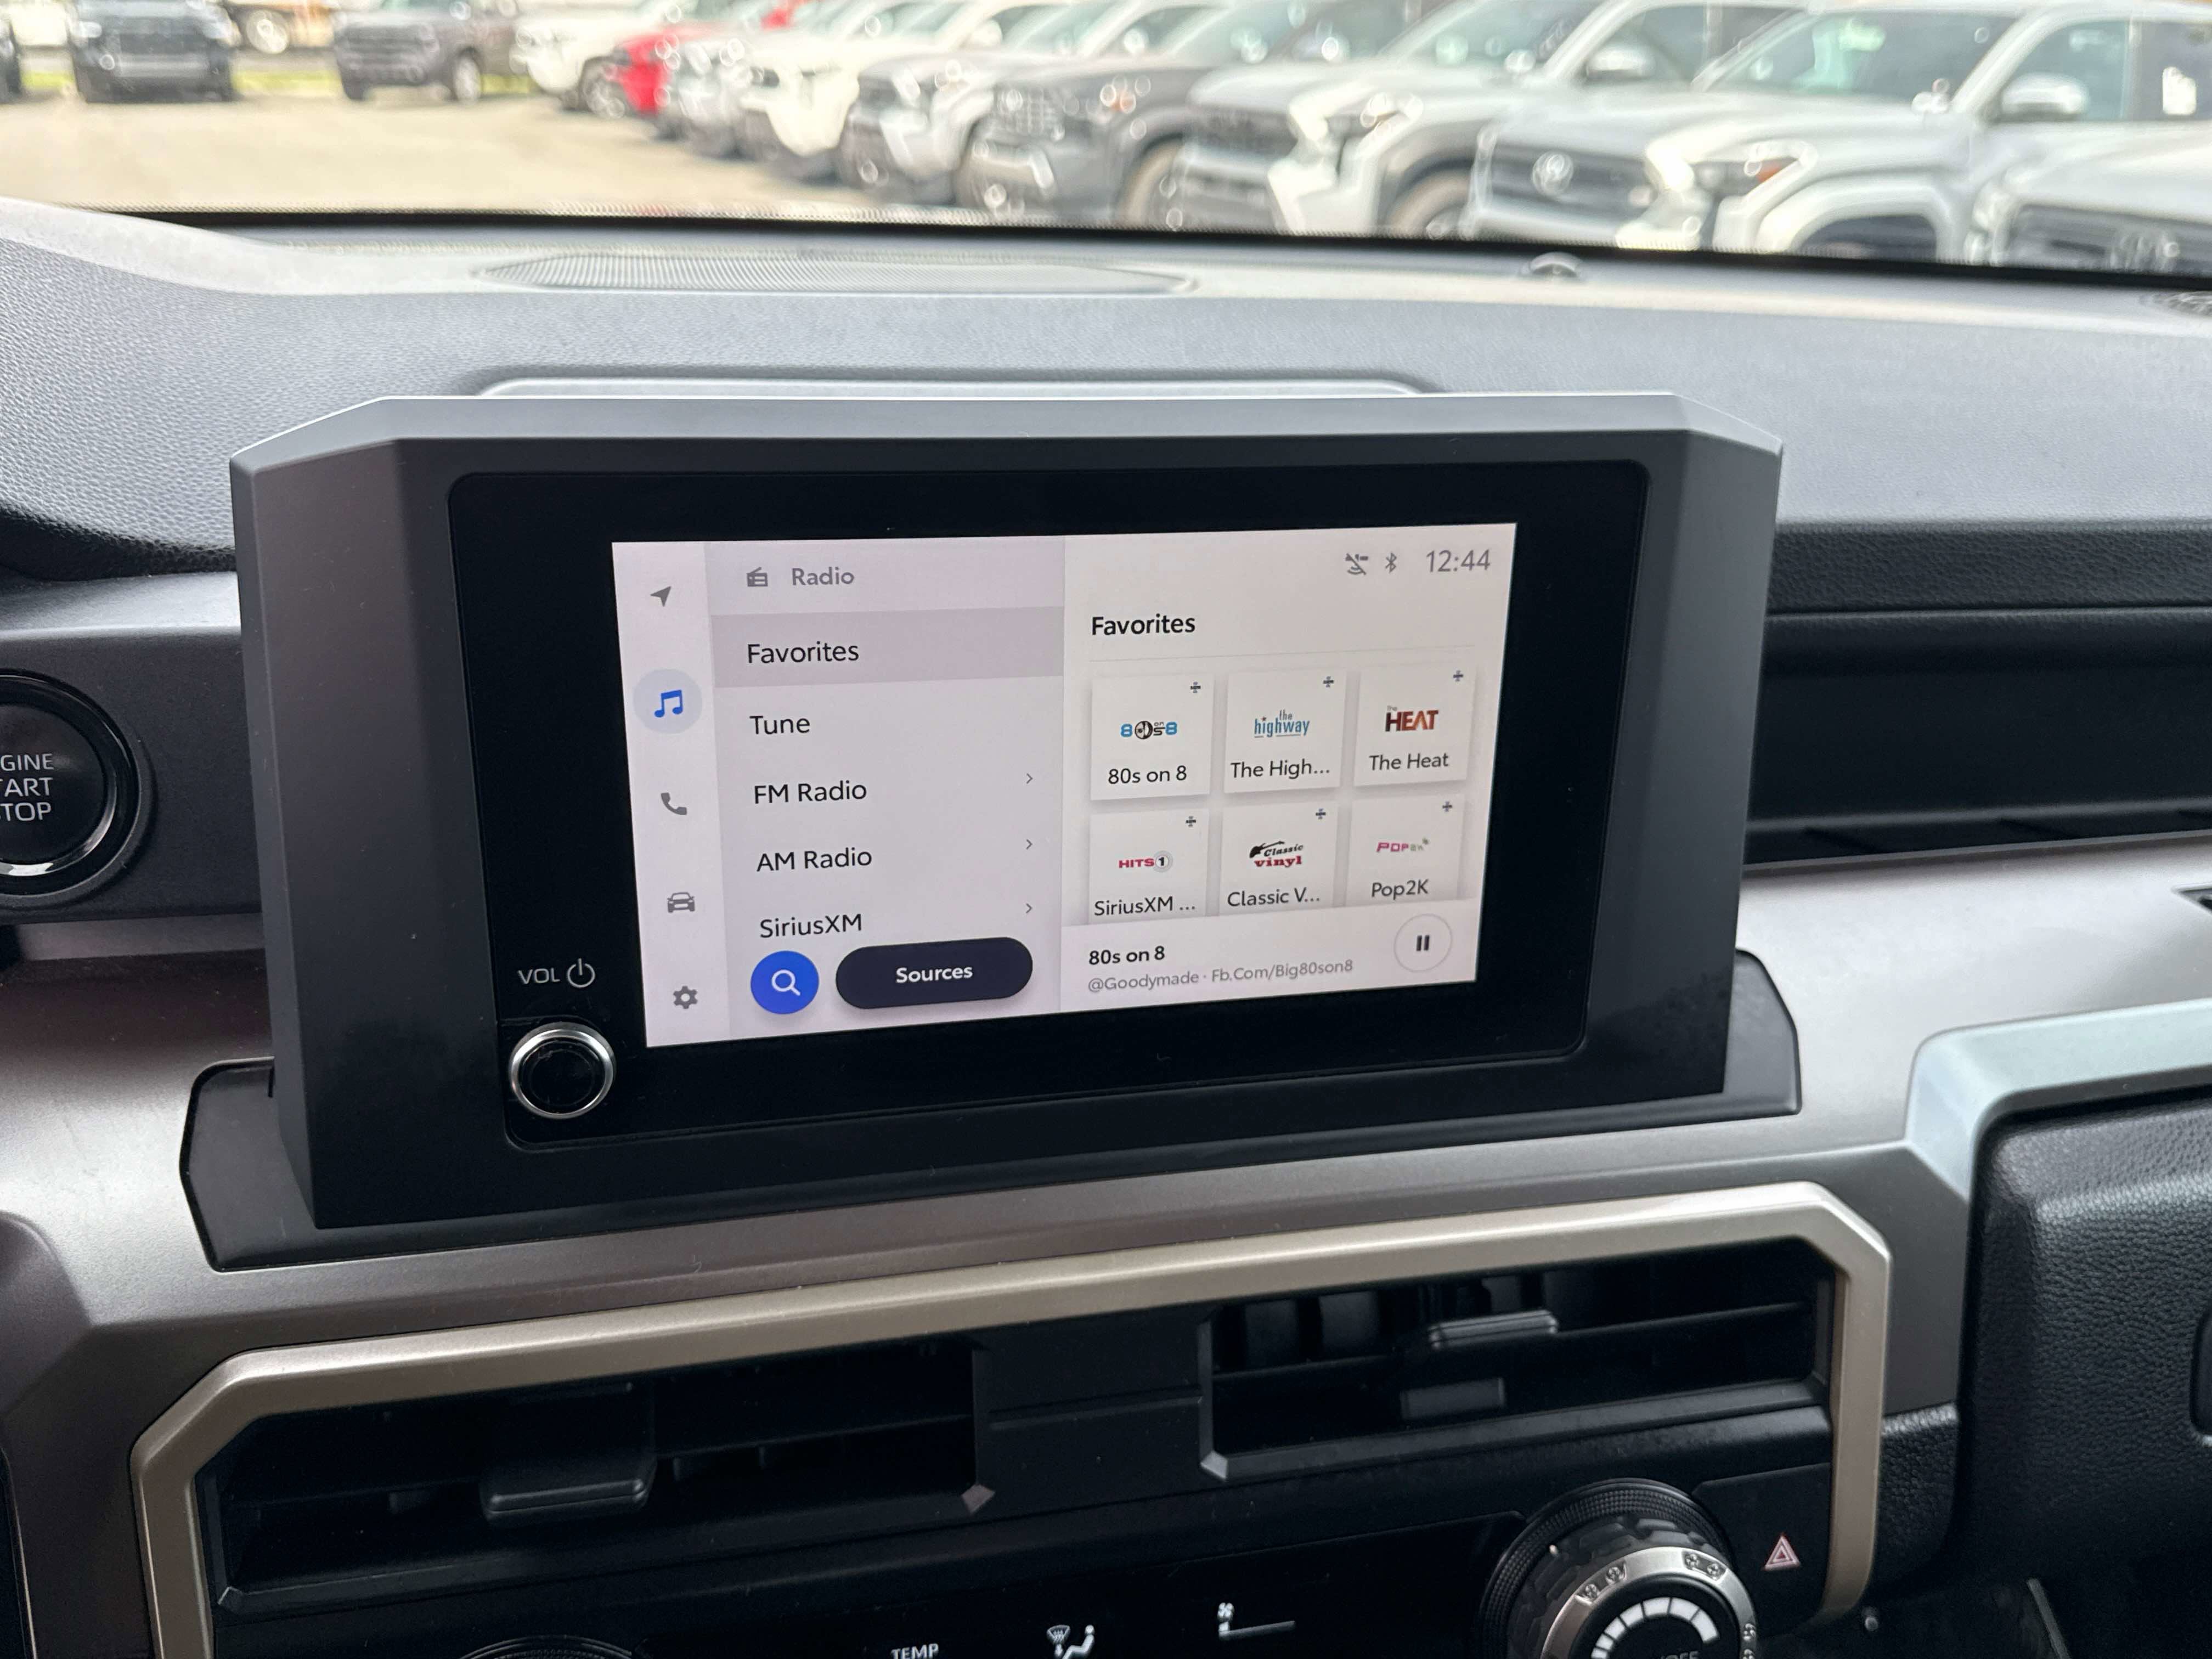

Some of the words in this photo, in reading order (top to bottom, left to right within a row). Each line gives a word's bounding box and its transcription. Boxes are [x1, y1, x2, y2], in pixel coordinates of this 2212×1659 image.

[1426, 549, 1491, 573] 12:44
[792, 566, 855, 586] Radio
[1092, 613, 1195, 636] Favorites
[747, 641, 859, 664] Favorites
[749, 715, 810, 735] Tune
[1279, 709, 1293, 721] the
[1385, 709, 1439, 732] HEAT
[1254, 717, 1310, 738] highway
[1230, 761, 1264, 778] The
[1369, 754, 1402, 771] The
[1407, 753, 1449, 769] Heat
[1108, 768, 1141, 785] 80s
[1146, 770, 1170, 782] on
[1176, 765, 1187, 781] 8
[0, 777, 53, 797] ART
[754, 784, 789, 804] FM
[798, 780, 867, 802] Radio
[0, 802, 52, 822] TOP
[757, 851, 795, 872] AM
[804, 847, 872, 869] Radio
[1264, 844, 1304, 857] Classic
[1118, 858, 1155, 868] HITS
[1254, 855, 1302, 868] vinyl
[1227, 889, 1289, 907] Classic
[1372, 879, 1428, 900] Pop2K
[1094, 896, 1173, 916] SiriusXM
[760, 913, 862, 938] SiriusXM
[1088, 950, 1121, 966] 80s
[1126, 951, 1149, 962] on
[1154, 945, 1165, 961] 8
[518, 968, 560, 985] VOL
[896, 967, 973, 984] Sources
[1088, 970, 1199, 993] @Goodymade
[1211, 958, 1353, 983] Fb.Com/Big80son8
[891, 1643, 939, 1659] TEMP
